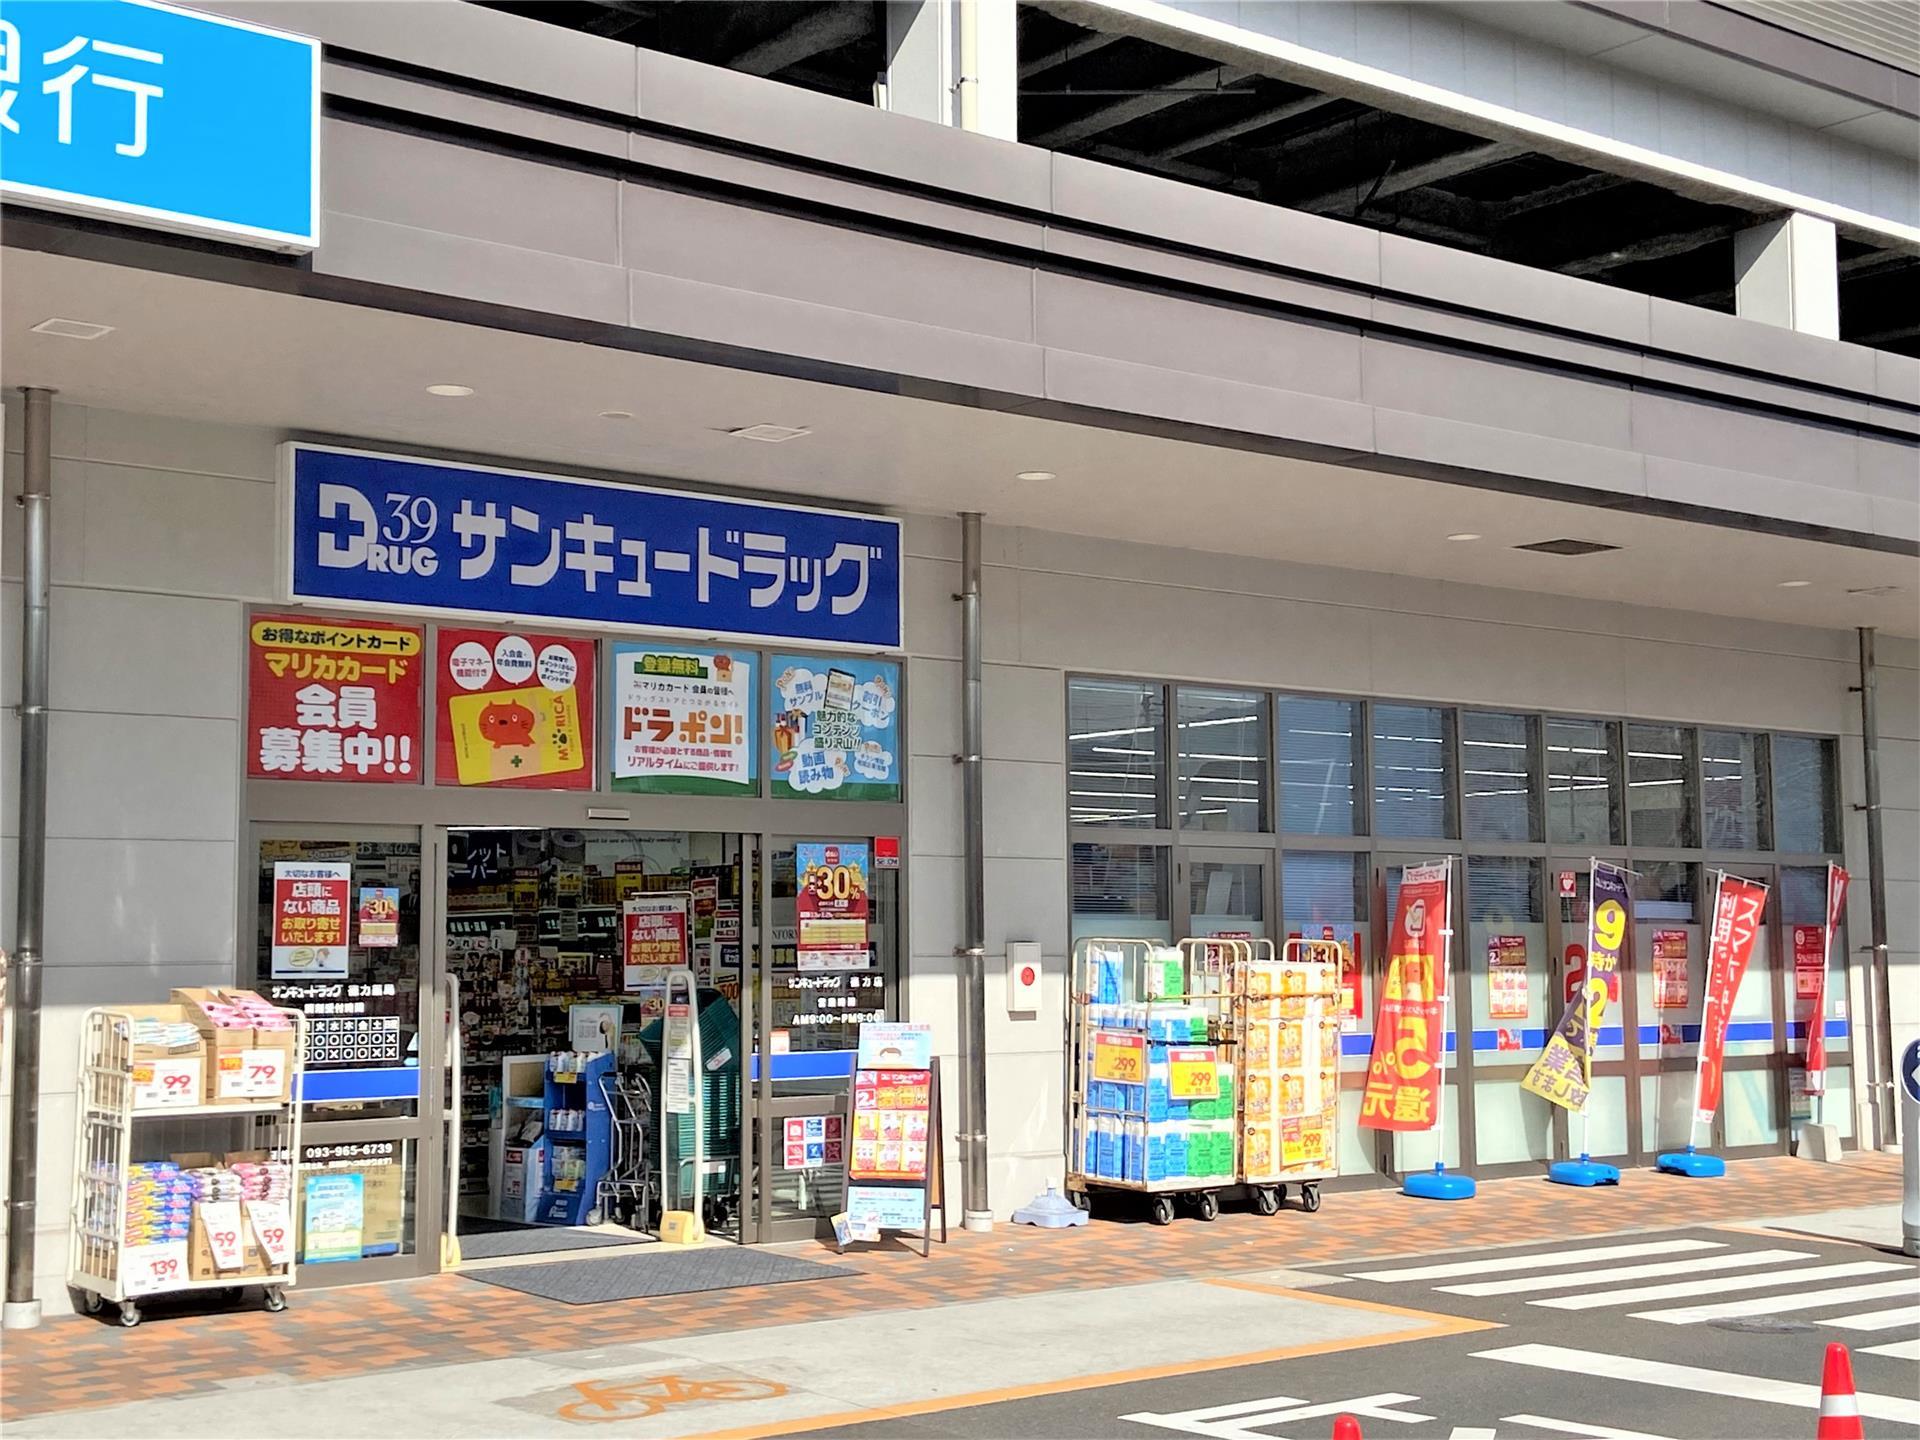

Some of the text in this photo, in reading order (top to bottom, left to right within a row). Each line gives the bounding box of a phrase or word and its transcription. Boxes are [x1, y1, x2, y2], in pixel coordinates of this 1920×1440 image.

[383, 492, 438, 543] 39
[318, 482, 438, 577] DRUG
[452, 499, 882, 615] サンキュードラッグ
[262, 627, 412, 652] お得なポイントカード
[265, 653, 409, 685] マリカカード
[452, 657, 492, 668] 電子マネー
[642, 654, 700, 676] 登録無料
[795, 681, 813, 695] 無料
[295, 683, 378, 730] 会員
[789, 691, 824, 708] サンプル
[863, 690, 883, 708] 割引
[816, 709, 857, 723] 魅力的な
[852, 701, 889, 721] クーポン
[813, 723, 861, 738] コンテンツ
[260, 727, 412, 775] 募集中!!
[801, 750, 826, 768] 動画
[798, 766, 835, 785] 読み物
[284, 869, 342, 879] 大切なお客様へ
[292, 882, 333, 899] 店頭に
[283, 899, 341, 916] ない商品
[281, 917, 341, 931] お取り寄せ
[1594, 899, 1626, 950] 9
[788, 975, 842, 989] サンキュードラッグ
[272, 984, 344, 999] サンキュードラッグ
[249, 1065, 276, 1079] 79
[1114, 1057, 1137, 1072] 299
[163, 1075, 191, 1089] 99
[1190, 1072, 1212, 1086] 299
[1303, 1133, 1321, 1147] 299
[306, 1143, 393, 1159] 093-965-6739
[213, 1231, 236, 1247] 59
[263, 1228, 285, 1244] 59
[150, 1258, 178, 1275] 139
